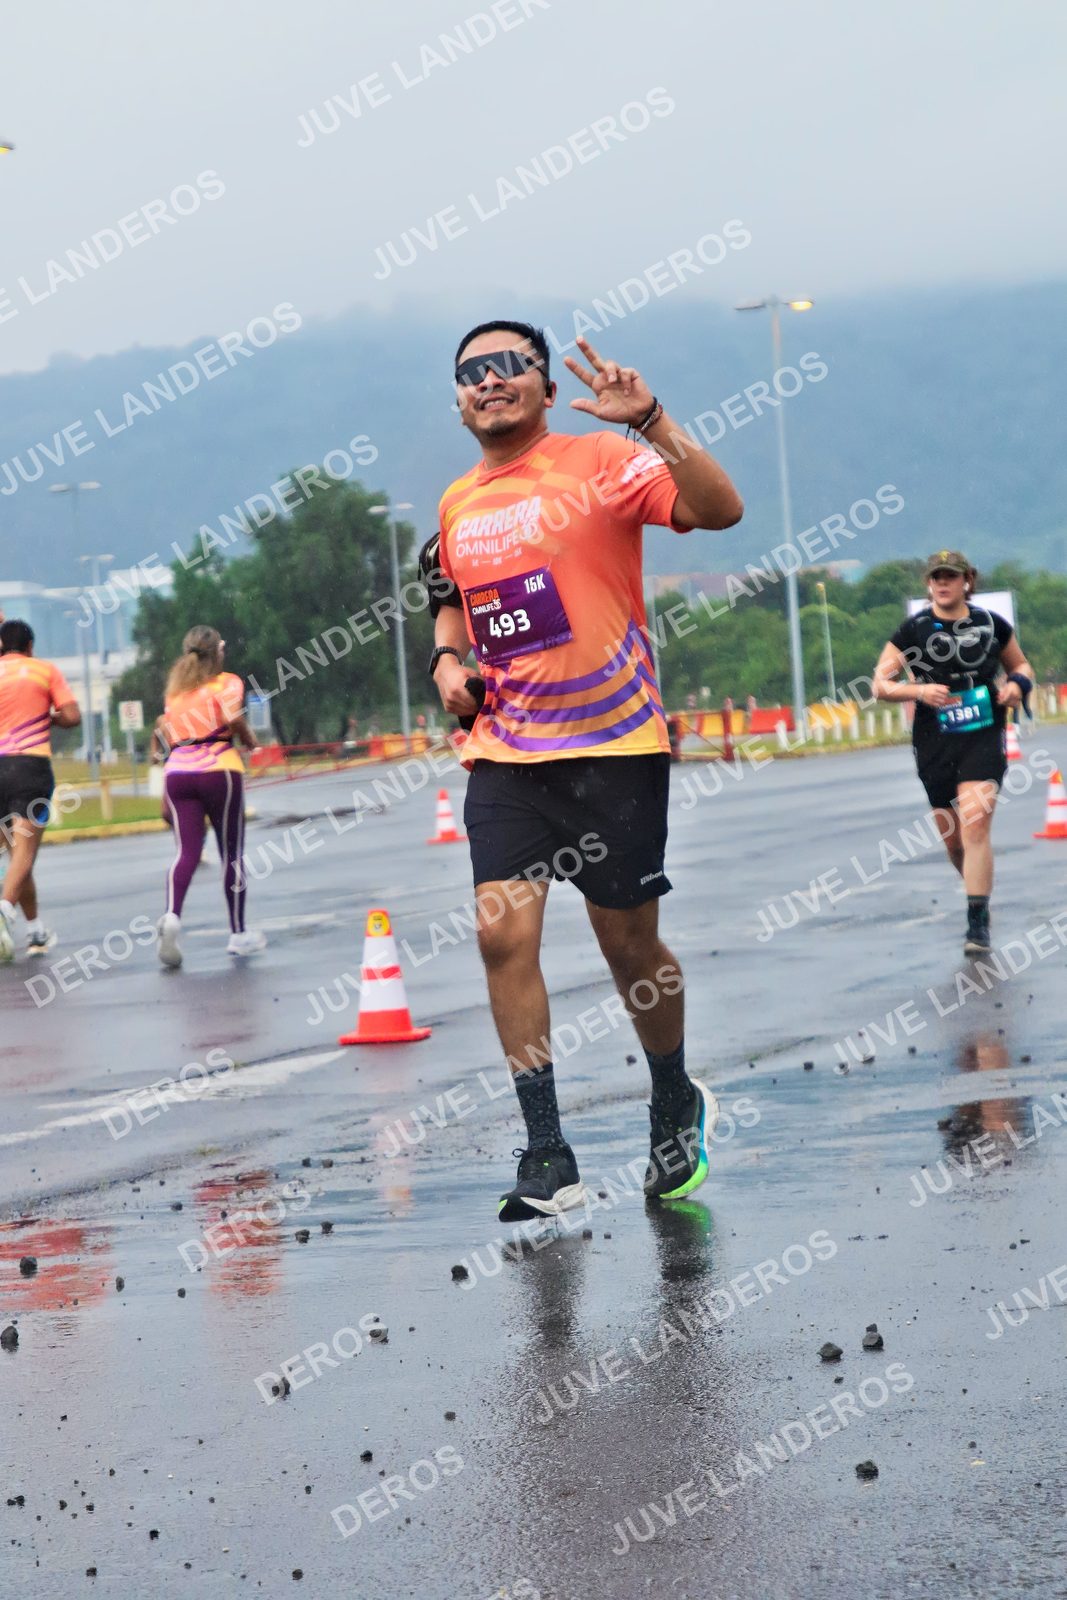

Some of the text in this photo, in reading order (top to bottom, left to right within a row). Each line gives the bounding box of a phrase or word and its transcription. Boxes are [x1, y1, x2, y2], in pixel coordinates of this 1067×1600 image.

[456, 496, 542, 542] CARRERA
[456, 530, 520, 558] OMNILIFE
[489, 608, 531, 638] 493
